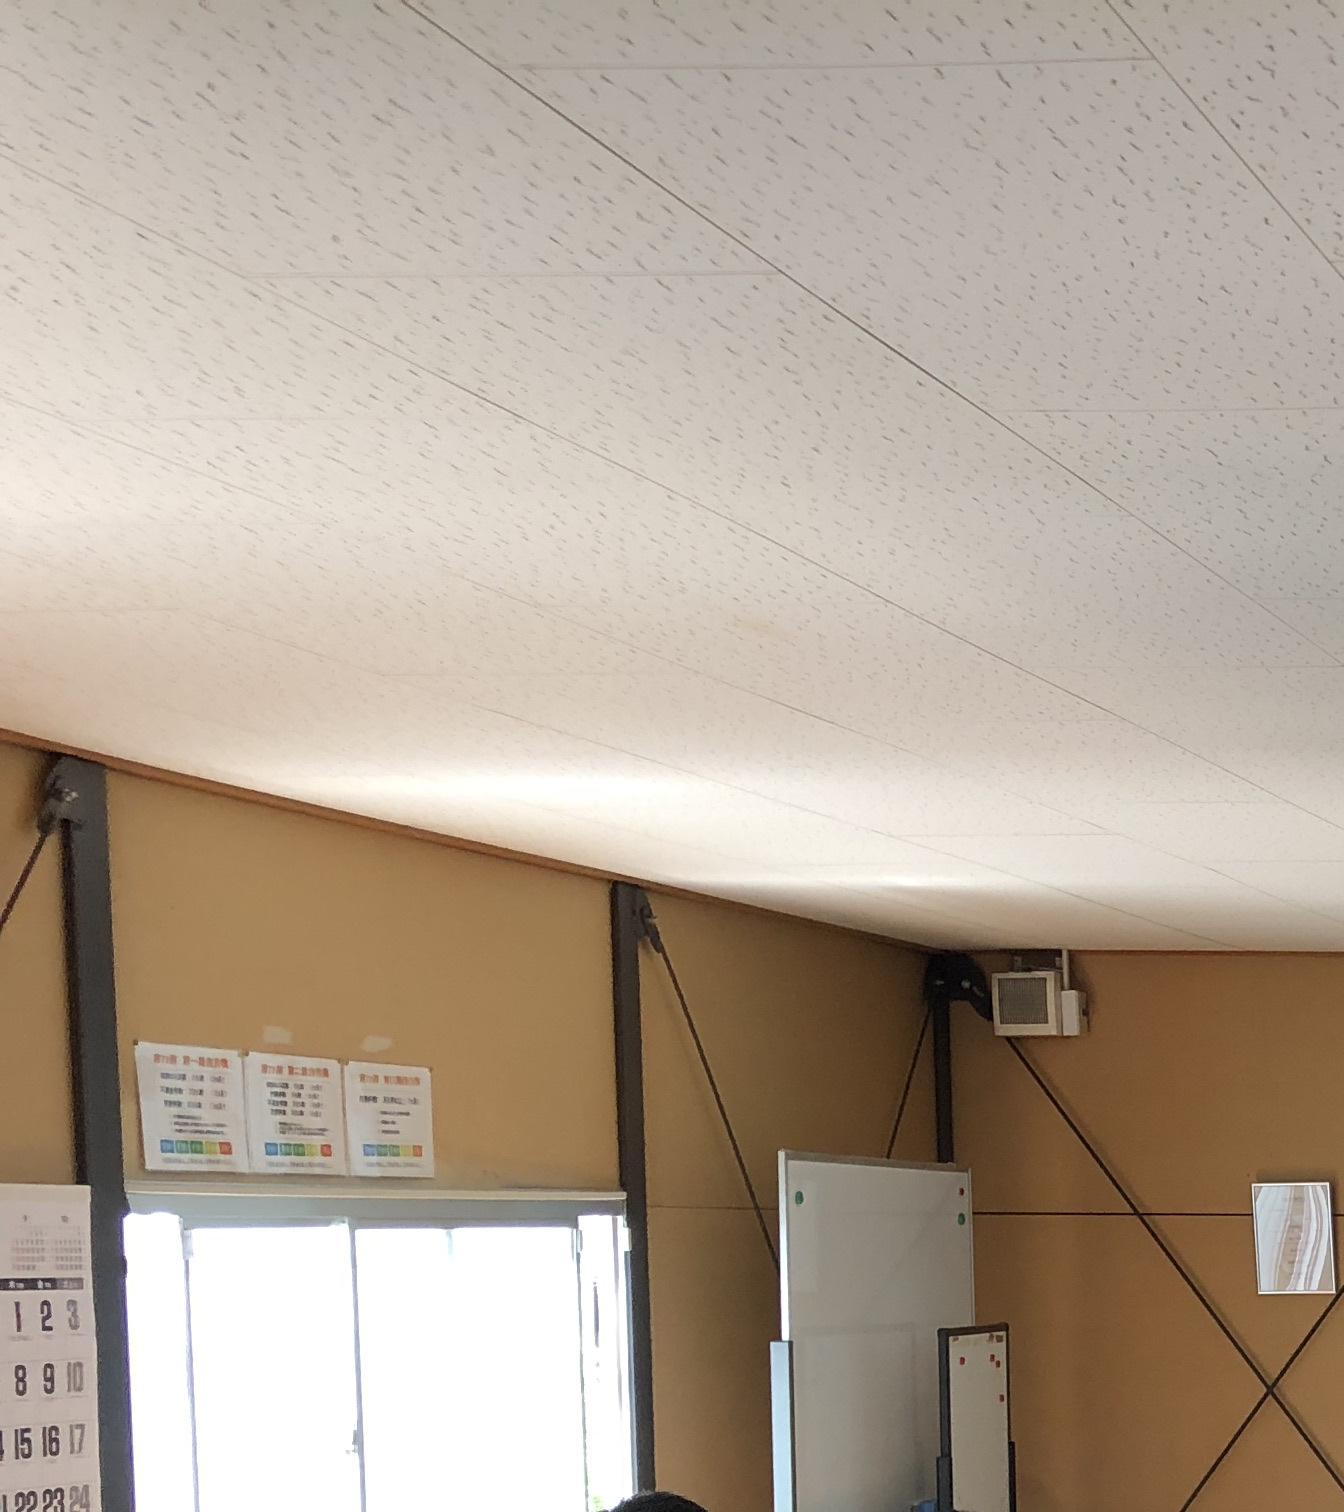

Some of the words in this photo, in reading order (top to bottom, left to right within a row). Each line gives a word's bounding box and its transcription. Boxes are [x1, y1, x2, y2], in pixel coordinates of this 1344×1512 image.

[14, 1301, 22, 1333] 1
[40, 1299, 53, 1332] 2
[66, 1299, 81, 1331] 3
[14, 1364, 27, 1396] 8
[43, 1362, 55, 1395] 9
[66, 1361, 84, 1393] 10
[14, 1427, 32, 1461] 15
[42, 1425, 60, 1457] 16
[69, 1424, 86, 1455] 17
